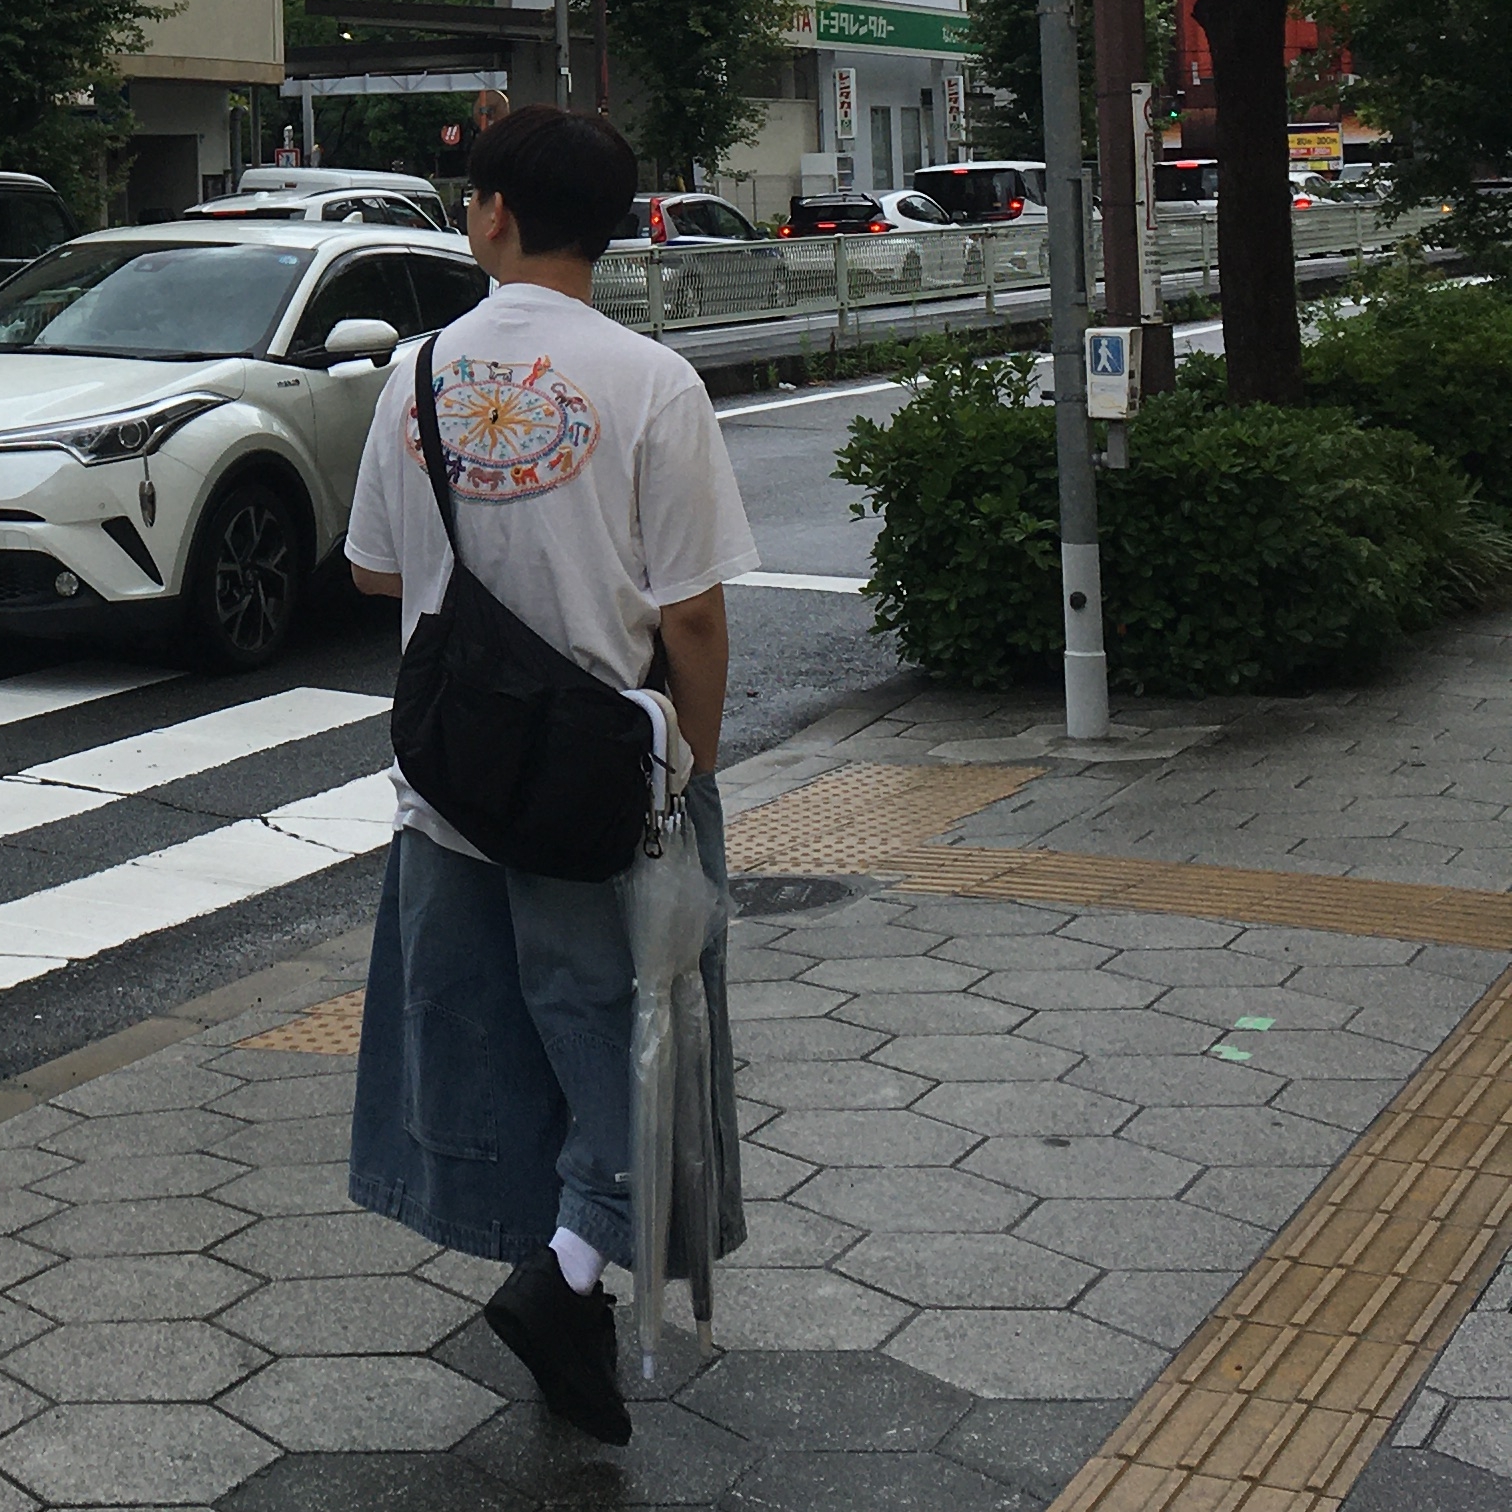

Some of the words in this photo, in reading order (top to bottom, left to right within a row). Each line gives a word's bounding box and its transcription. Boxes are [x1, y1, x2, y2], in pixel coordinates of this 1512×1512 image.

[820, 10, 895, 38] トヨタレンタカー
[838, 72, 851, 118] レンタカー
